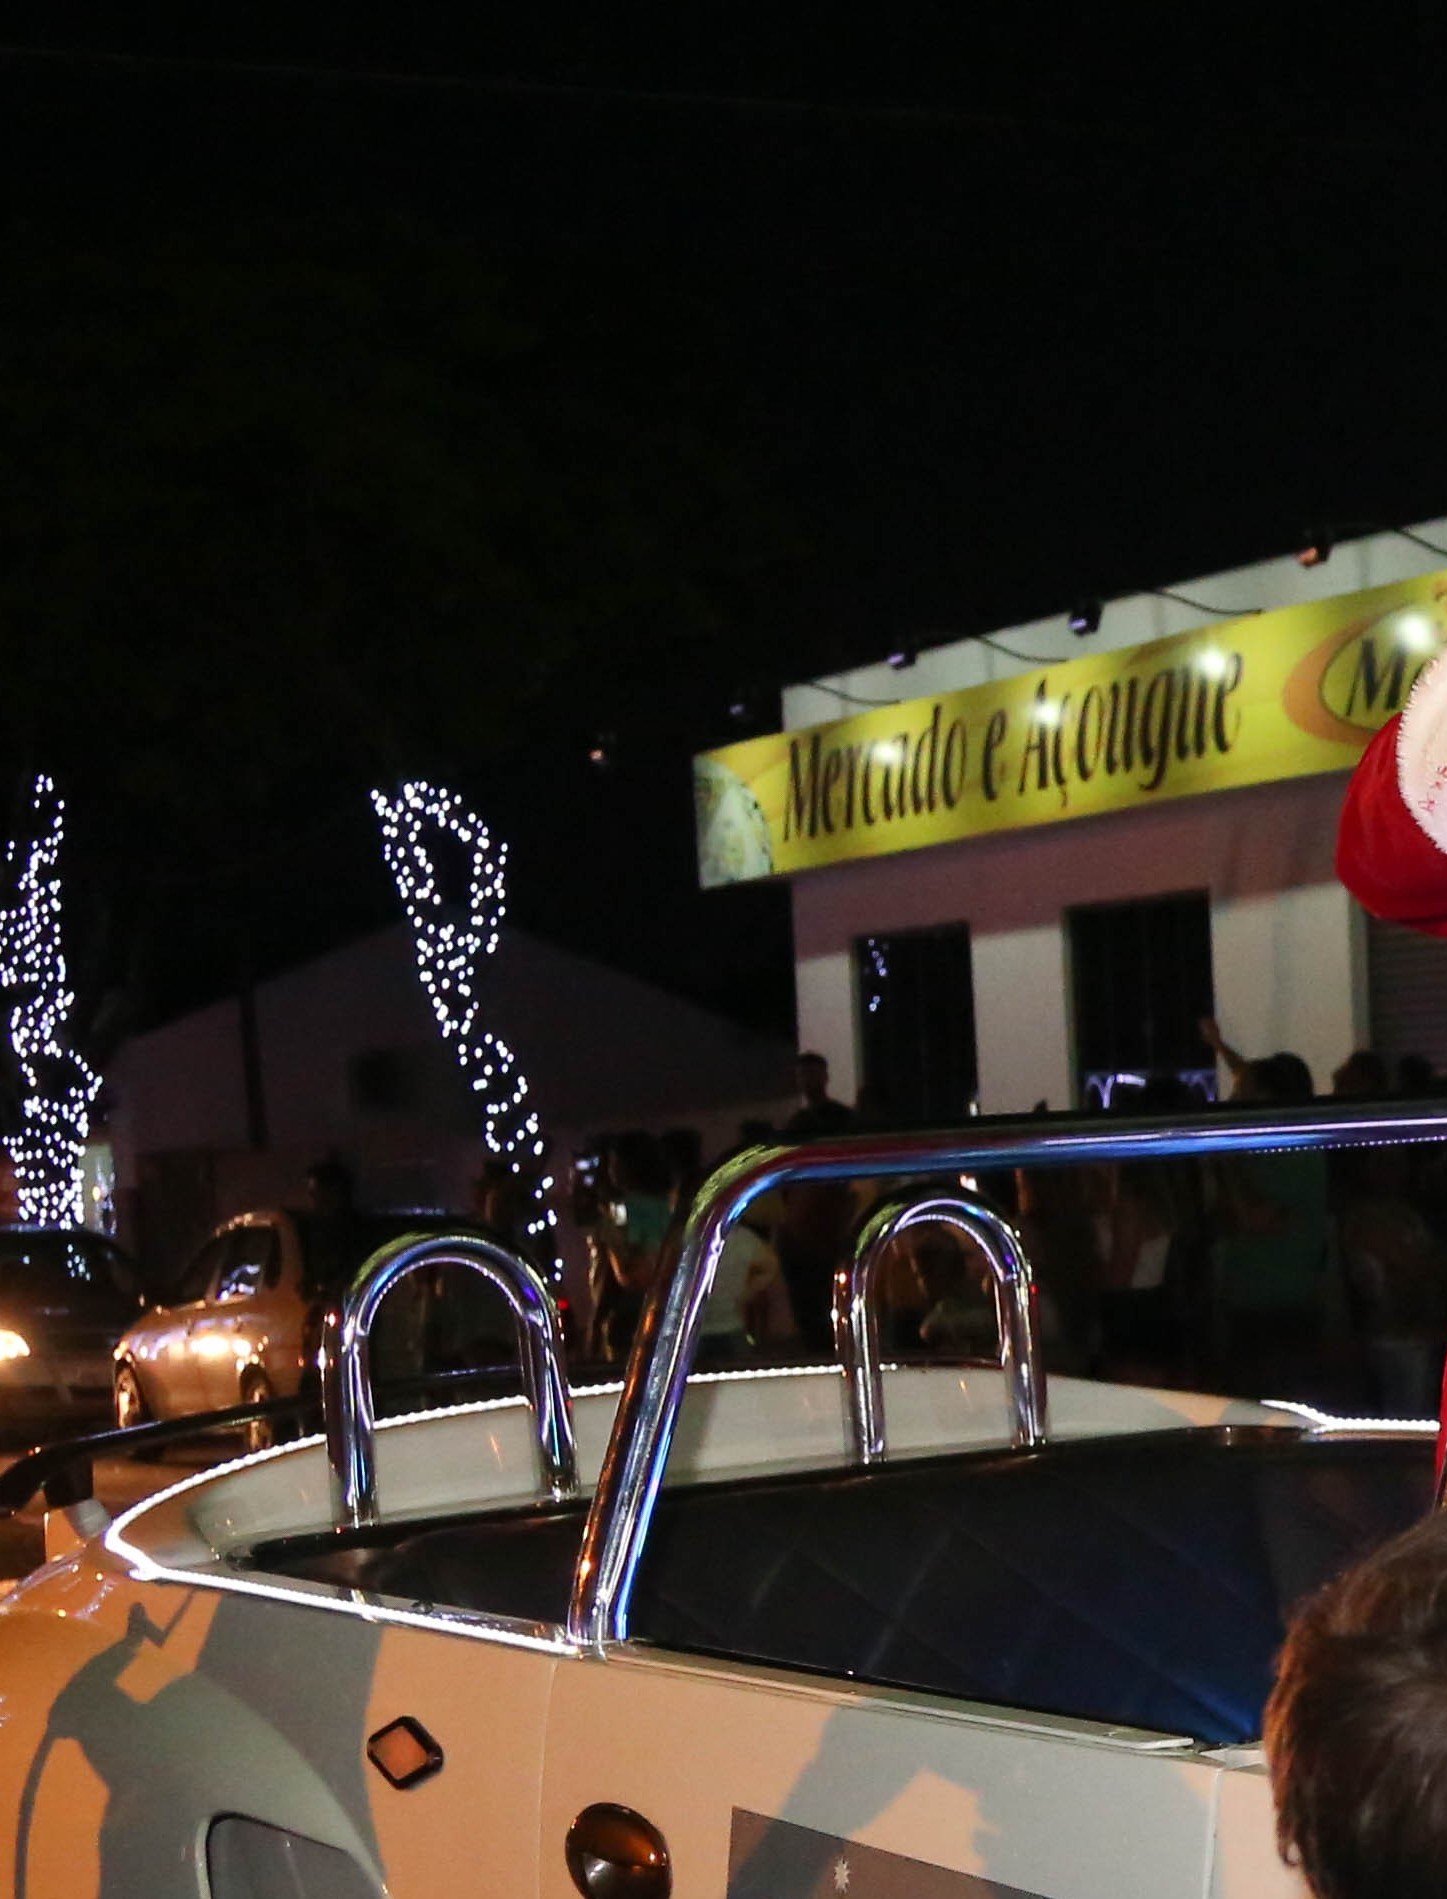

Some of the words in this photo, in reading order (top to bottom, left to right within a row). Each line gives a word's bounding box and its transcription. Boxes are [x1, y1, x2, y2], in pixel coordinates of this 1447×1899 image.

[784, 702, 967, 842] Mercado
[982, 707, 1007, 802] e
[1018, 653, 1243, 808] Açougue
